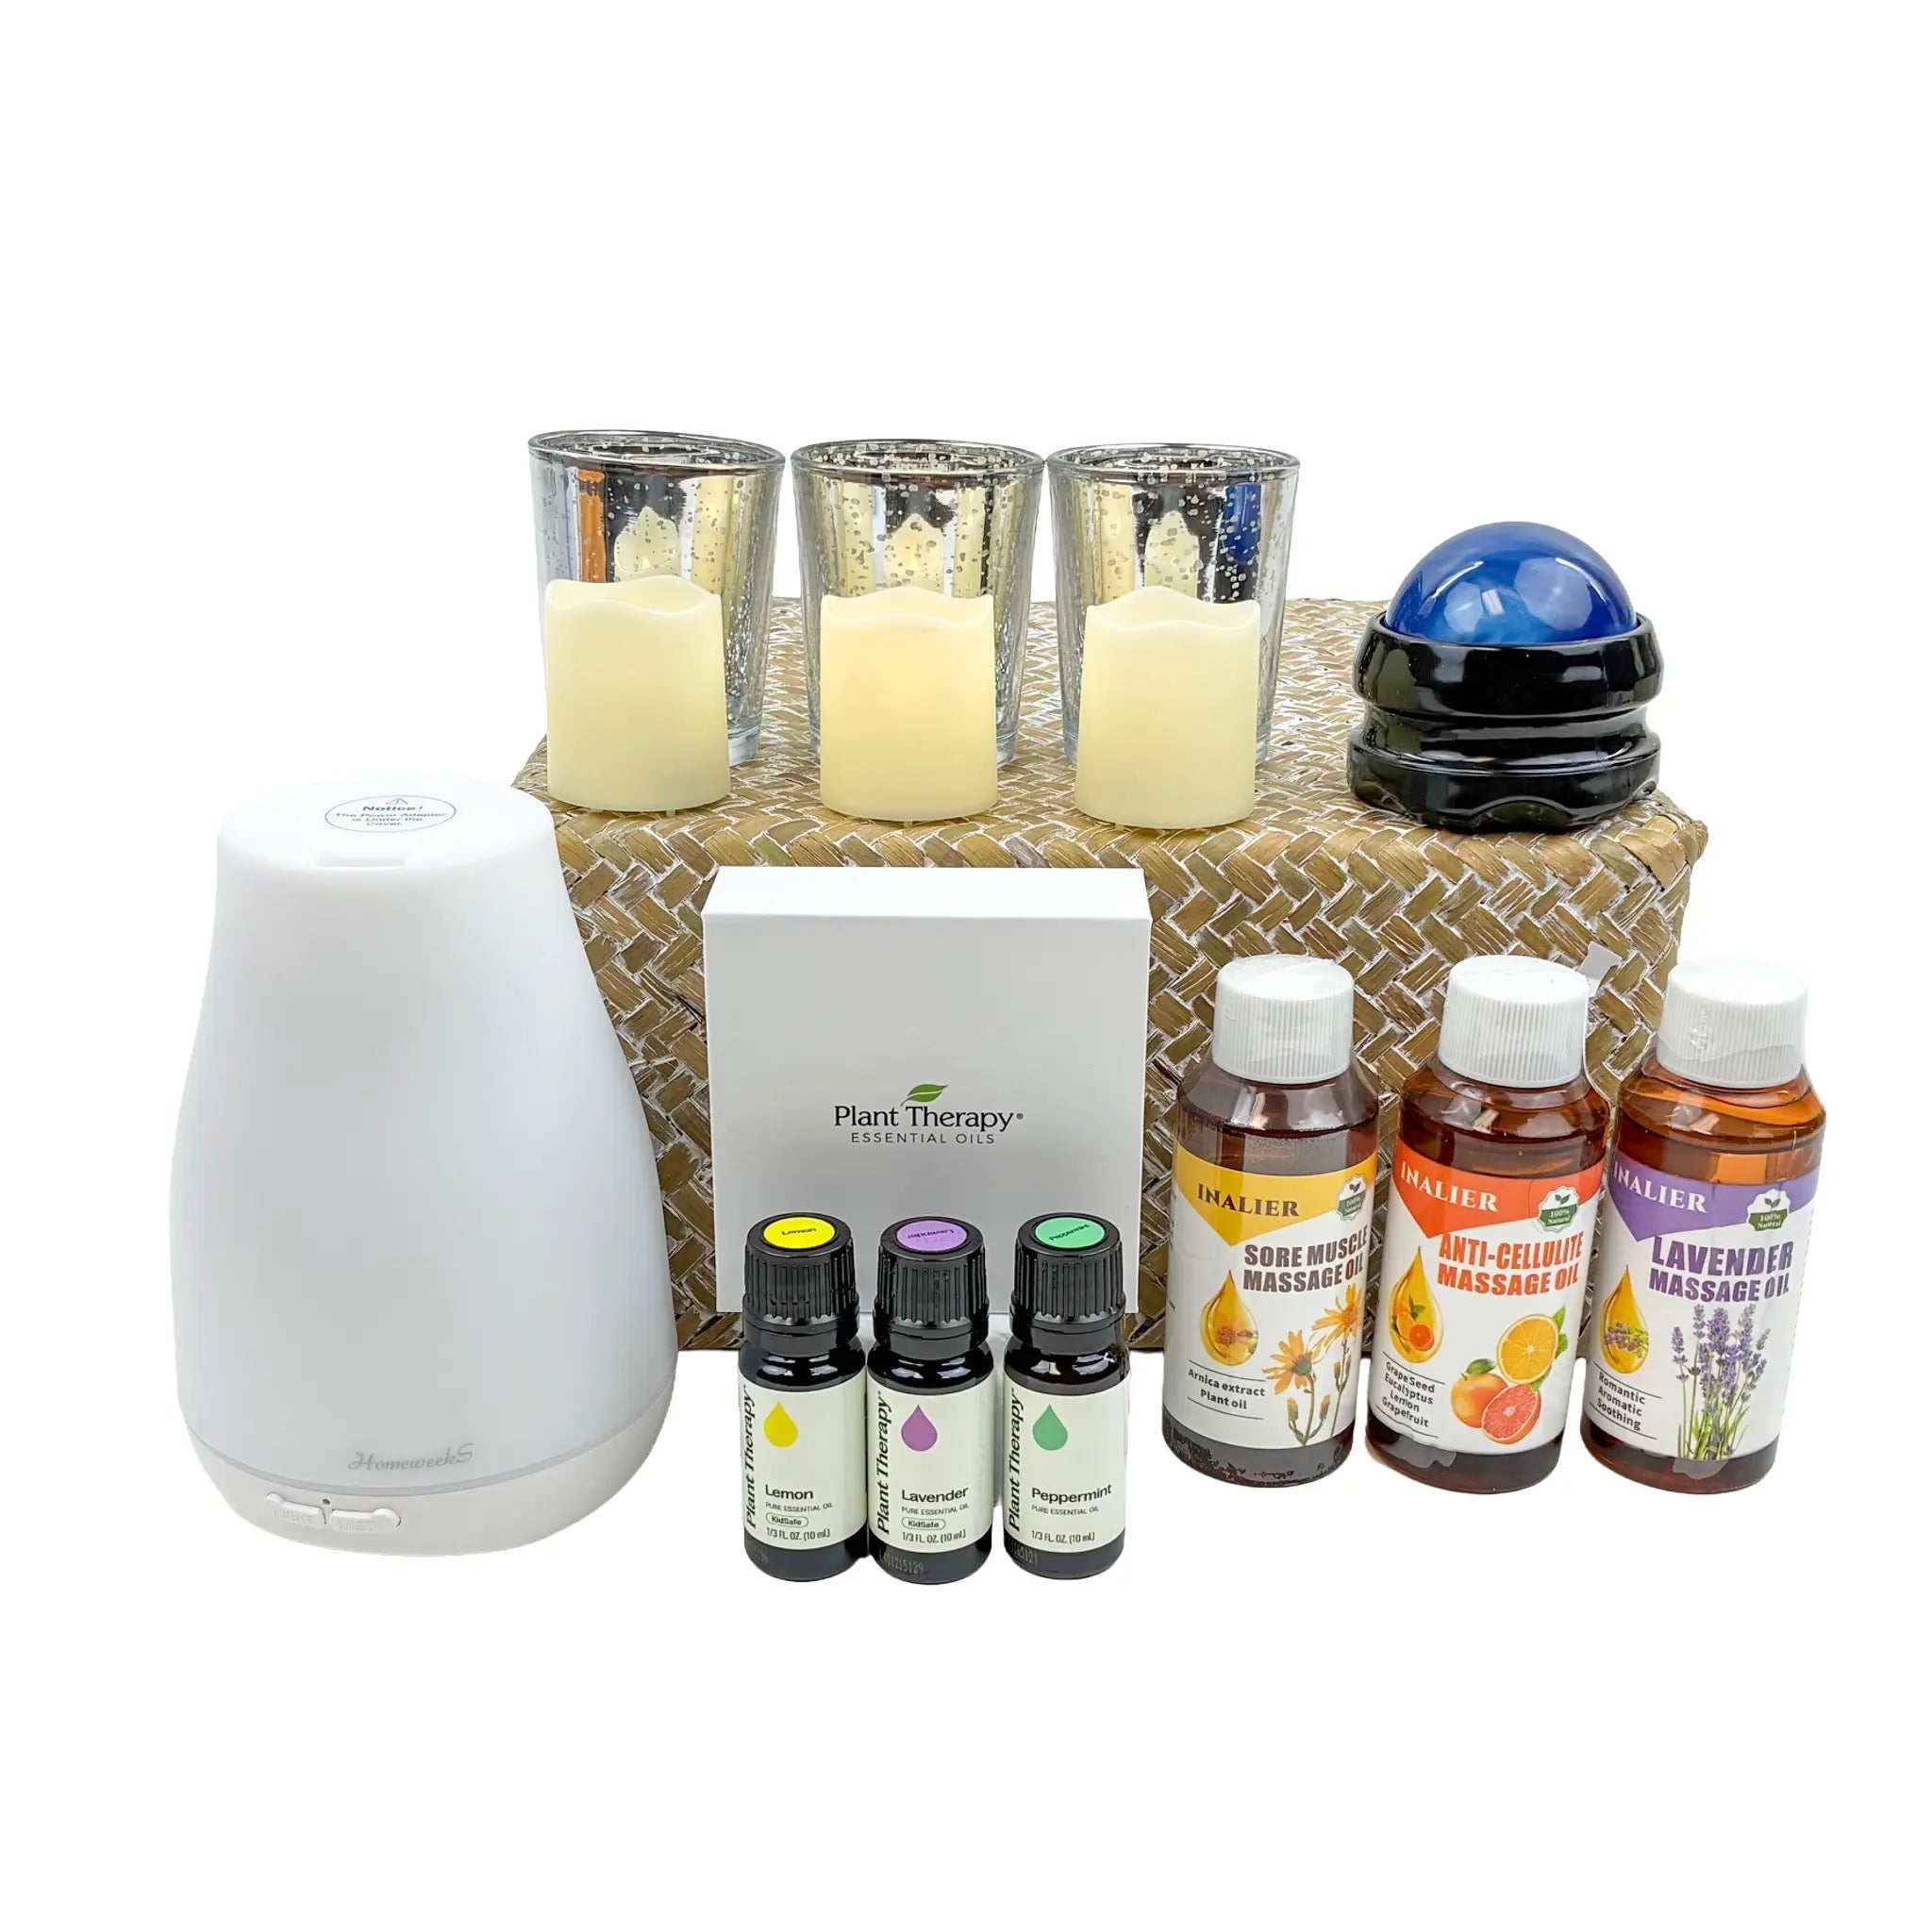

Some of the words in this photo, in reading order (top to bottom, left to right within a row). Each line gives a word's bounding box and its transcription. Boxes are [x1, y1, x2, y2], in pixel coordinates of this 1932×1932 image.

[834, 1105, 899, 1126] Plant
[851, 1132, 946, 1143] ESSENTIAL
[956, 1133, 995, 1144] OILS
[1196, 1183, 1301, 1218] INALIER
[1400, 1160, 1499, 1213] INALIER
[1612, 1159, 1708, 1214] INALIER
[1550, 1208, 1570, 1219] 100%
[1244, 1244, 1304, 1268] SORE
[1307, 1224, 1369, 1265] MUSCLE
[1439, 1230, 1585, 1270] ANTI-CELLULITE
[1652, 1235, 1794, 1276] LAVENDER
[1243, 1268, 1342, 1293] MASSAGE
[1345, 1254, 1364, 1282] OIL
[1437, 1263, 1550, 1296] MASSAGE
[1556, 1263, 1578, 1291] OIL
[1648, 1268, 1759, 1303] MASSAGE
[1764, 1274, 1790, 1300] OIL
[1188, 1368, 1220, 1390] Arnica
[1222, 1380, 1266, 1398] extract
[1384, 1373, 1434, 1406] Eucalyptus
[1598, 1371, 1645, 1406] Romantic
[1200, 1389, 1229, 1408] Plant
[1231, 1397, 1248, 1410] oil
[1381, 1395, 1430, 1428] Grapefruit
[1390, 1389, 1420, 1413] Lemon
[1597, 1385, 1642, 1417] Aromatic
[1596, 1400, 1641, 1431] Soothing
[746, 1475, 757, 1529] Plant
[765, 1484, 814, 1500] Lemon
[765, 1502, 782, 1511] PURE
[902, 1487, 969, 1503] Lavender
[1008, 1477, 1021, 1533] Plant
[1031, 1484, 1112, 1505] Peppermint
[771, 1516, 802, 1526] KidSafe
[877, 1479, 890, 1536] Plant
[902, 1507, 919, 1515] PURE
[921, 1507, 958, 1516] ESSENTIAL
[1031, 1506, 1049, 1515] PURE
[1050, 1507, 1088, 1516] ESSENTIAL
[766, 1527, 777, 1539] 1/3
[804, 1528, 816, 1541] (10
[902, 1531, 914, 1542] 1/3
[940, 1531, 953, 1544] (10
[908, 1520, 940, 1529] KidSafe
[1031, 1530, 1043, 1541] 1/3
[1069, 1532, 1081, 1544] (10
